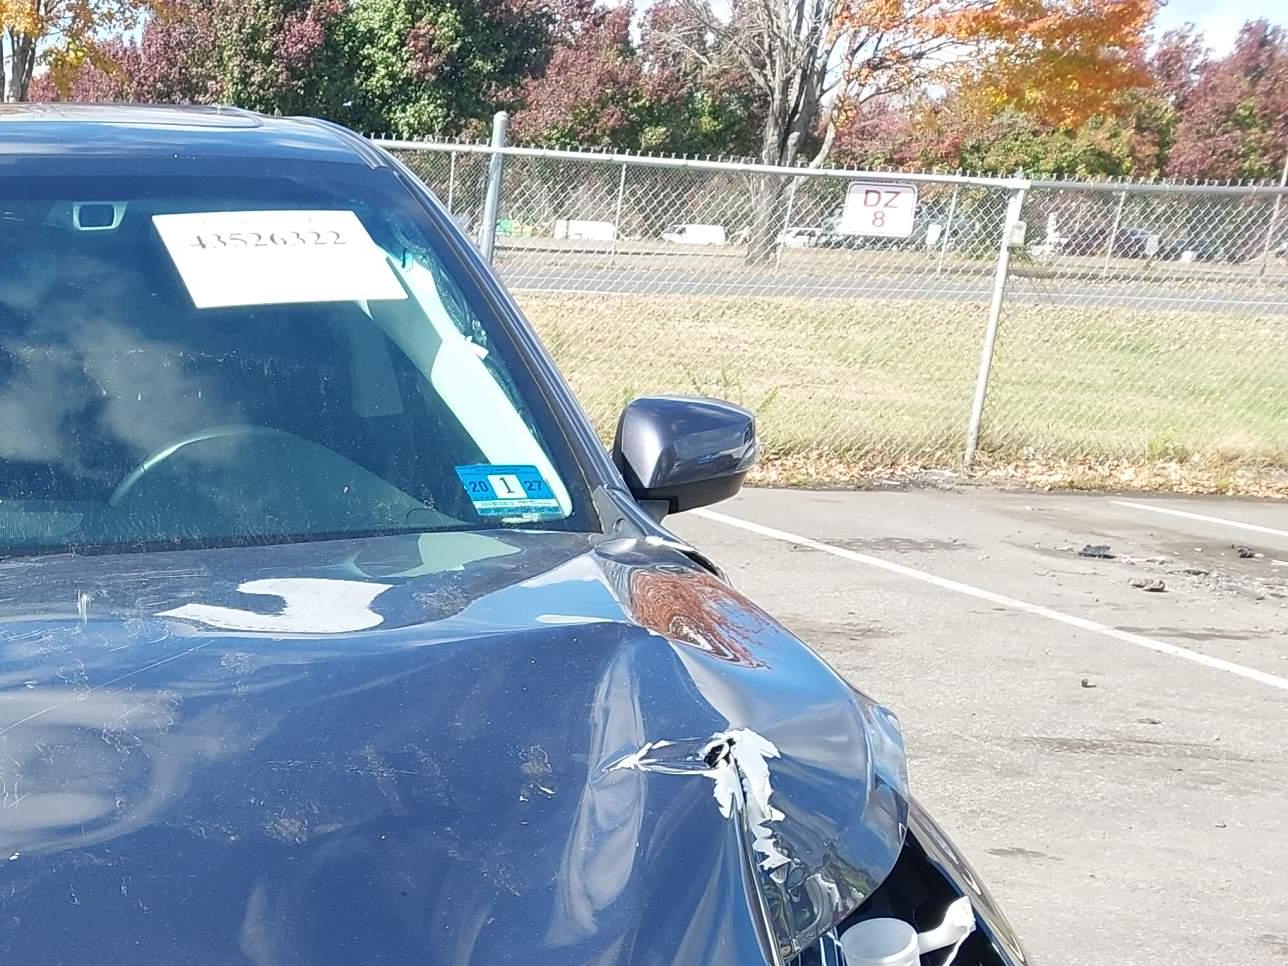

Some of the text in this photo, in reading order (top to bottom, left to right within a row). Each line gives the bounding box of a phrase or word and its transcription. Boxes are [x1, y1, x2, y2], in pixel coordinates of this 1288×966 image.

[863, 189, 901, 208] DZ
[872, 210, 885, 227] 8
[190, 230, 347, 249] 43526322
[469, 476, 542, 493] 20 1 27
